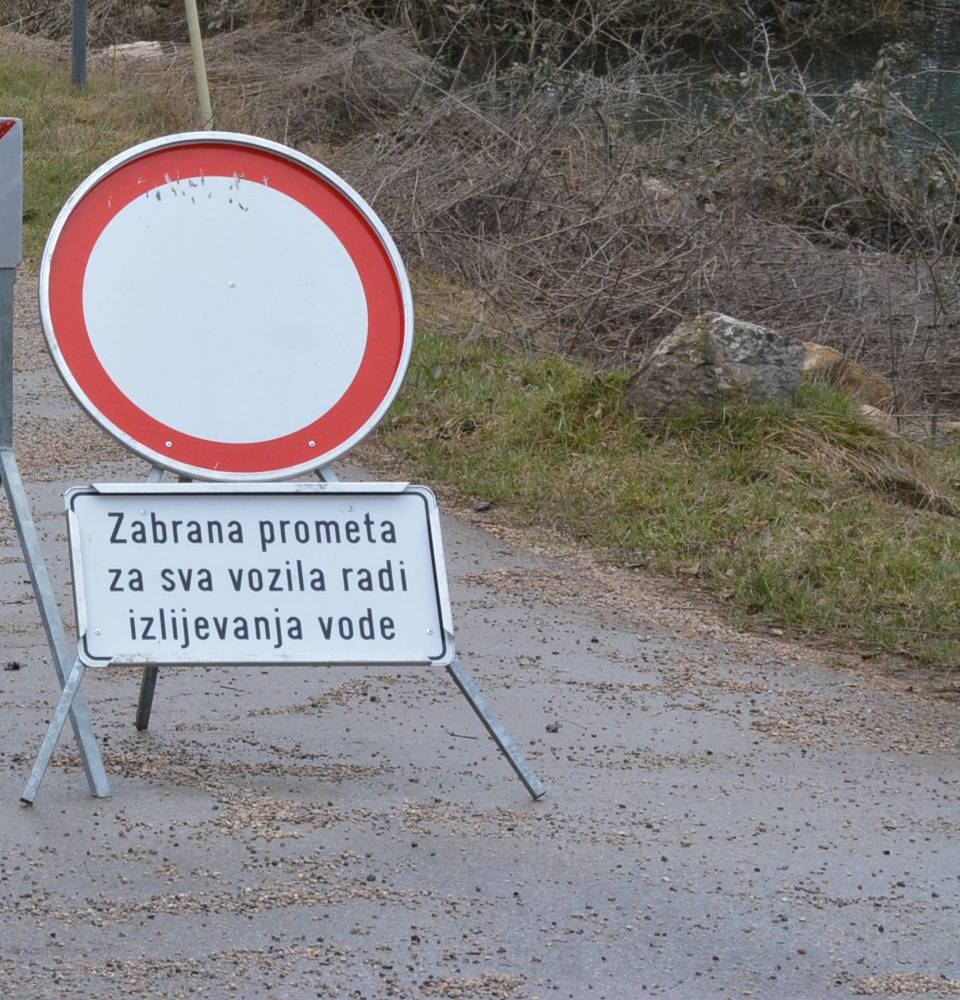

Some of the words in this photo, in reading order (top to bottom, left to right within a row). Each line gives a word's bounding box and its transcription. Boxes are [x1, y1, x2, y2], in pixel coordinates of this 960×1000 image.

[107, 511, 244, 544] Zabrana
[258, 512, 397, 553] prometa
[108, 568, 144, 592] za
[160, 568, 214, 592] sva
[228, 559, 326, 592] vozila
[341, 559, 408, 592] radi
[129, 607, 303, 649] izlijevanja
[317, 607, 396, 641] vode
